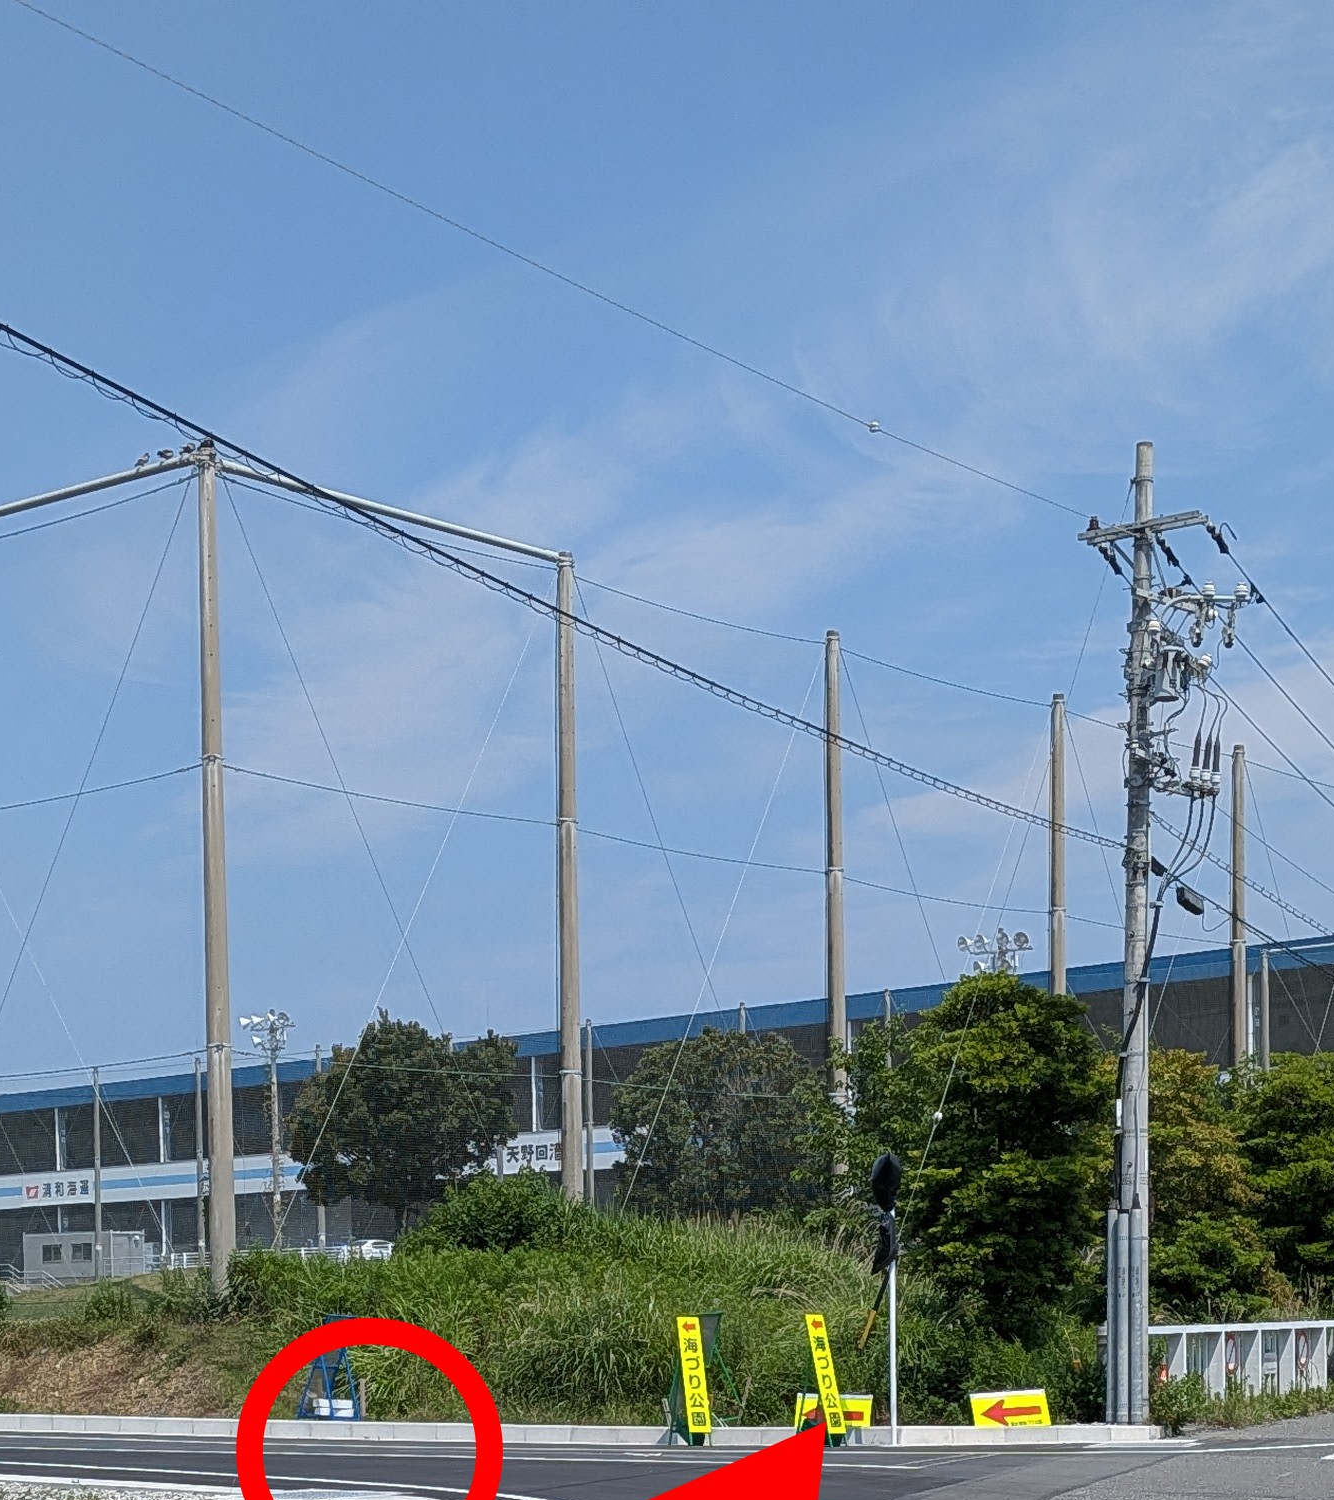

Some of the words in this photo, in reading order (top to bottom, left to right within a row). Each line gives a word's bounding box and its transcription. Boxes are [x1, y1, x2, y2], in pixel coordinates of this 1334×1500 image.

[683, 1337, 707, 1427] 海づり公園
[812, 1335, 842, 1428] 海づり公園
